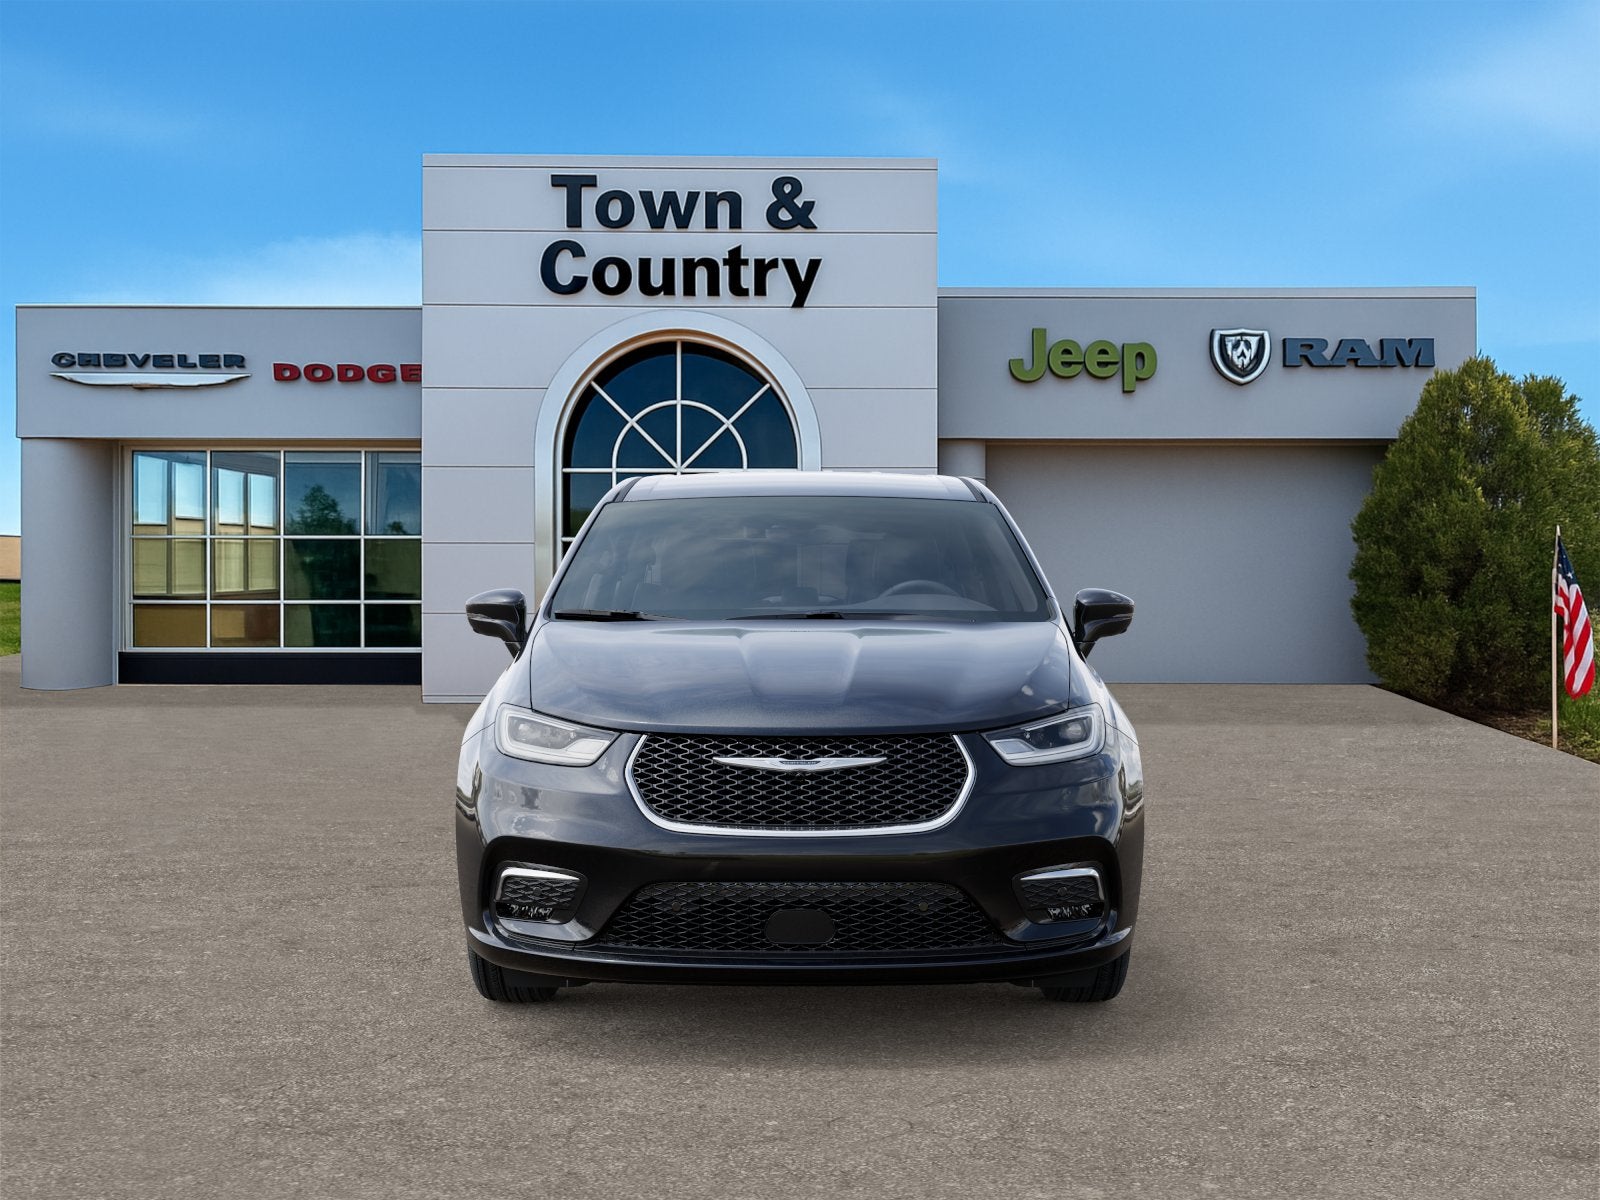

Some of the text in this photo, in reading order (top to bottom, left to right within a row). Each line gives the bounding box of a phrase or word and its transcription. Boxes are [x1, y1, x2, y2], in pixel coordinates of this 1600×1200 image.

[551, 174, 818, 229] Town &
[540, 239, 822, 308] Country
[273, 363, 422, 383] DODGE
[1008, 328, 1157, 393] Jeep
[1283, 338, 1435, 367] RAM
